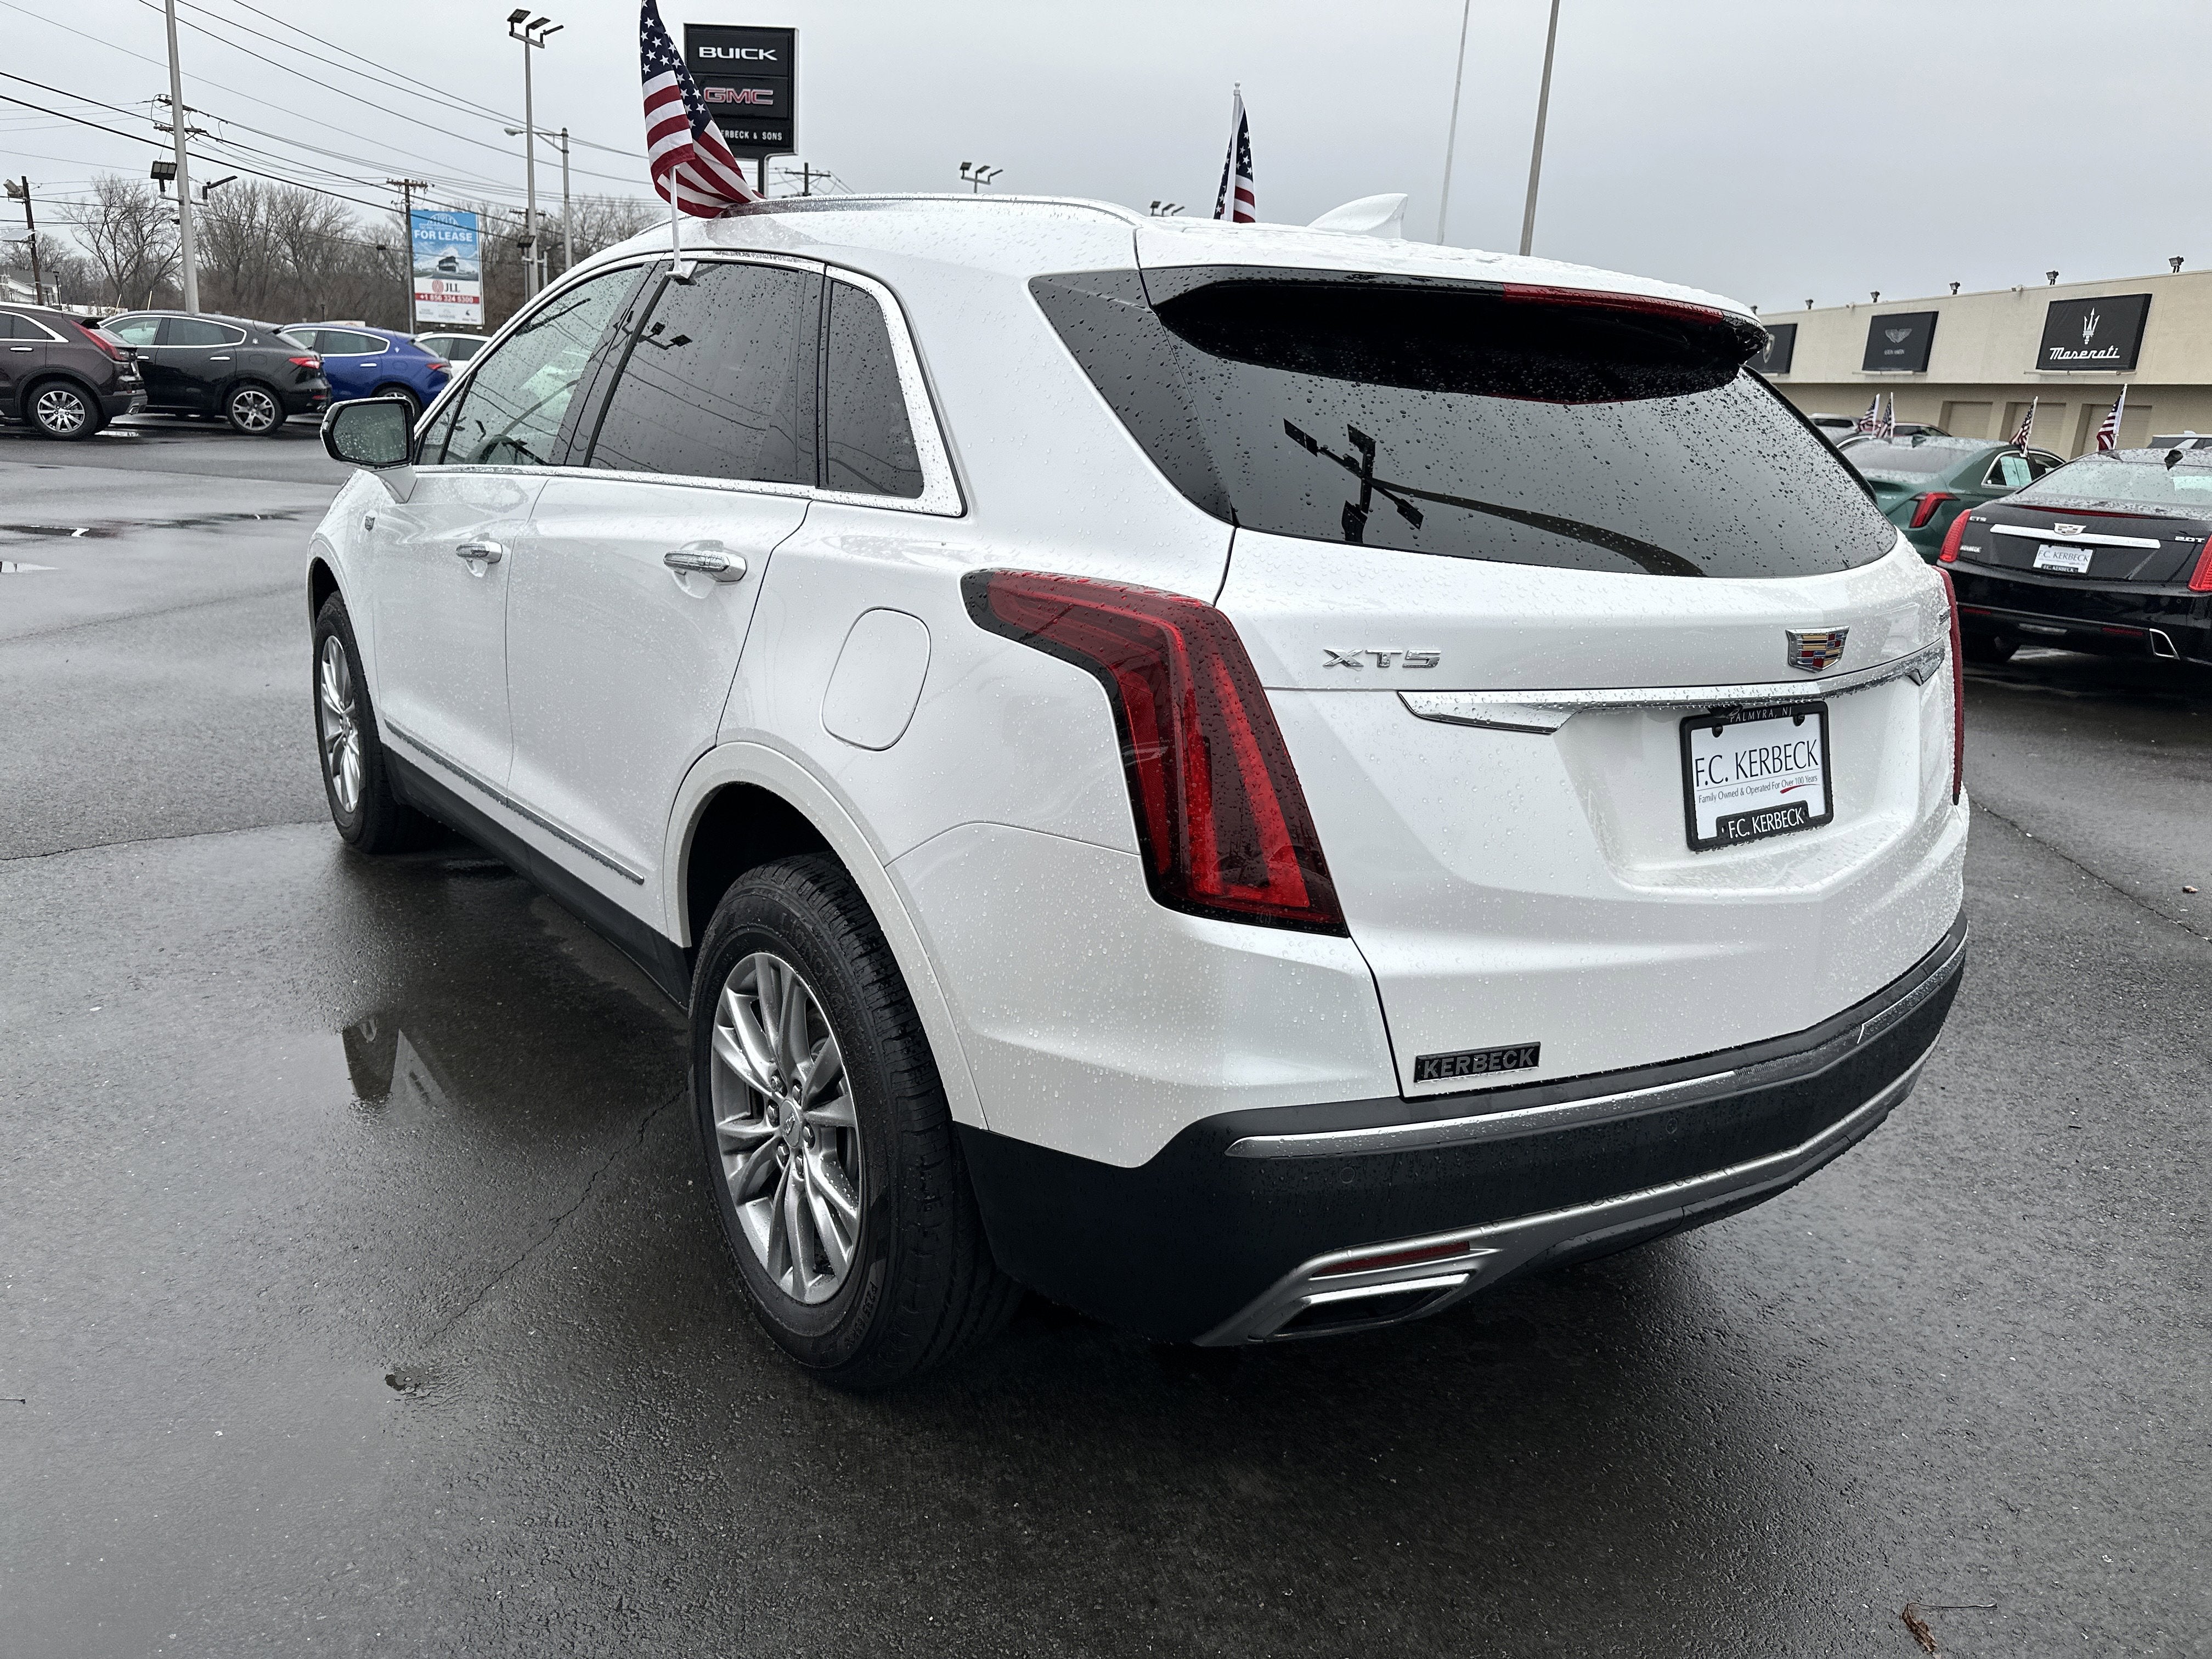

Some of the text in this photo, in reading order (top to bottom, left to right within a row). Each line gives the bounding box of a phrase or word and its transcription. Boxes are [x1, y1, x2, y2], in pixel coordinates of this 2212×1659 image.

[699, 47, 777, 61] BUICK
[703, 86, 774, 105] GMC
[720, 129, 782, 141] ERBECK & SONS
[414, 229, 473, 242] FOR LEASE
[444, 283, 461, 293] JLL
[2050, 345, 2120, 360] Maserati
[2038, 550, 2051, 558] F.C.
[2053, 551, 2090, 562] KERBECK
[1322, 648, 1442, 669] XT5
[1729, 706, 1792, 723] PALMYRA, NJ
[1695, 739, 1819, 787] F.C. KERBECK
[1699, 791, 1717, 804] Family
[1718, 787, 1739, 800] Owned
[1740, 787, 1745, 796] &
[1746, 781, 1771, 795] Operated
[1781, 779, 1794, 788] Over
[1795, 777, 1804, 785] 100
[1804, 774, 1818, 783] Years
[1728, 807, 1804, 839] F.C. KERBECK
[1423, 1047, 1535, 1079] KERBECK
